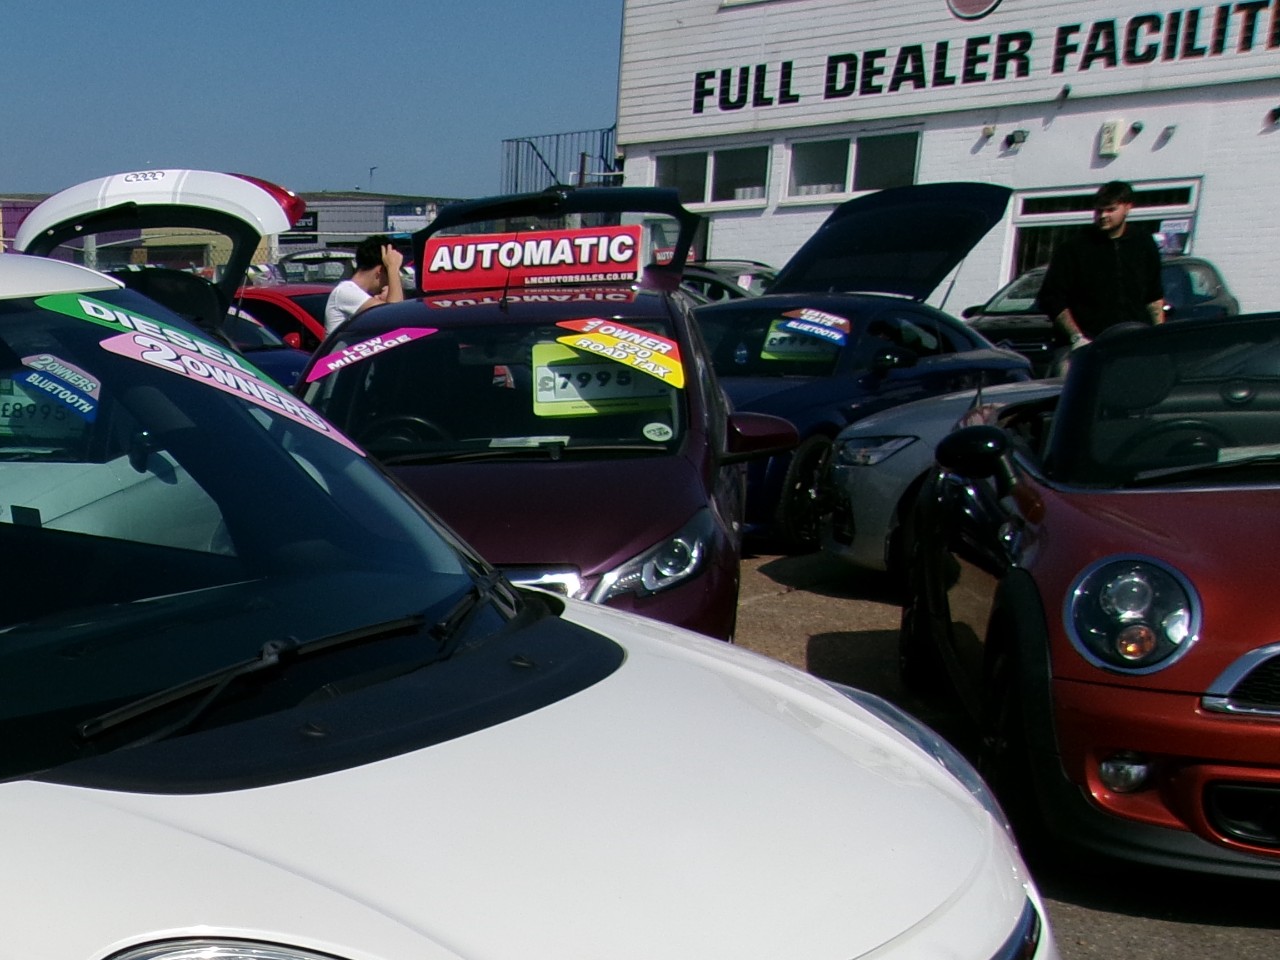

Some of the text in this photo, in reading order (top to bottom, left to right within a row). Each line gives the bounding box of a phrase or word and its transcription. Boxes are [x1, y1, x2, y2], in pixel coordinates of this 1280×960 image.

[692, 60, 800, 115] FULL
[823, 31, 1033, 99] DEALER
[428, 234, 635, 273] AUTOMATIC
[524, 272, 634, 285] LMCMOTORSALES.CO.UK
[77, 298, 257, 379] DIESEL
[341, 336, 383, 357] LOW
[598, 325, 673, 354] OWNER
[786, 320, 843, 341] BLUETOOTH
[326, 333, 413, 371] MILEAGE
[575, 338, 673, 378] ROAD TAX
[616, 342, 654, 359] £20
[25, 372, 95, 414] BLUETOOTH
[46, 361, 97, 393] OWNERS
[180, 354, 330, 433] OWNERS
[538, 370, 633, 393] £7995
